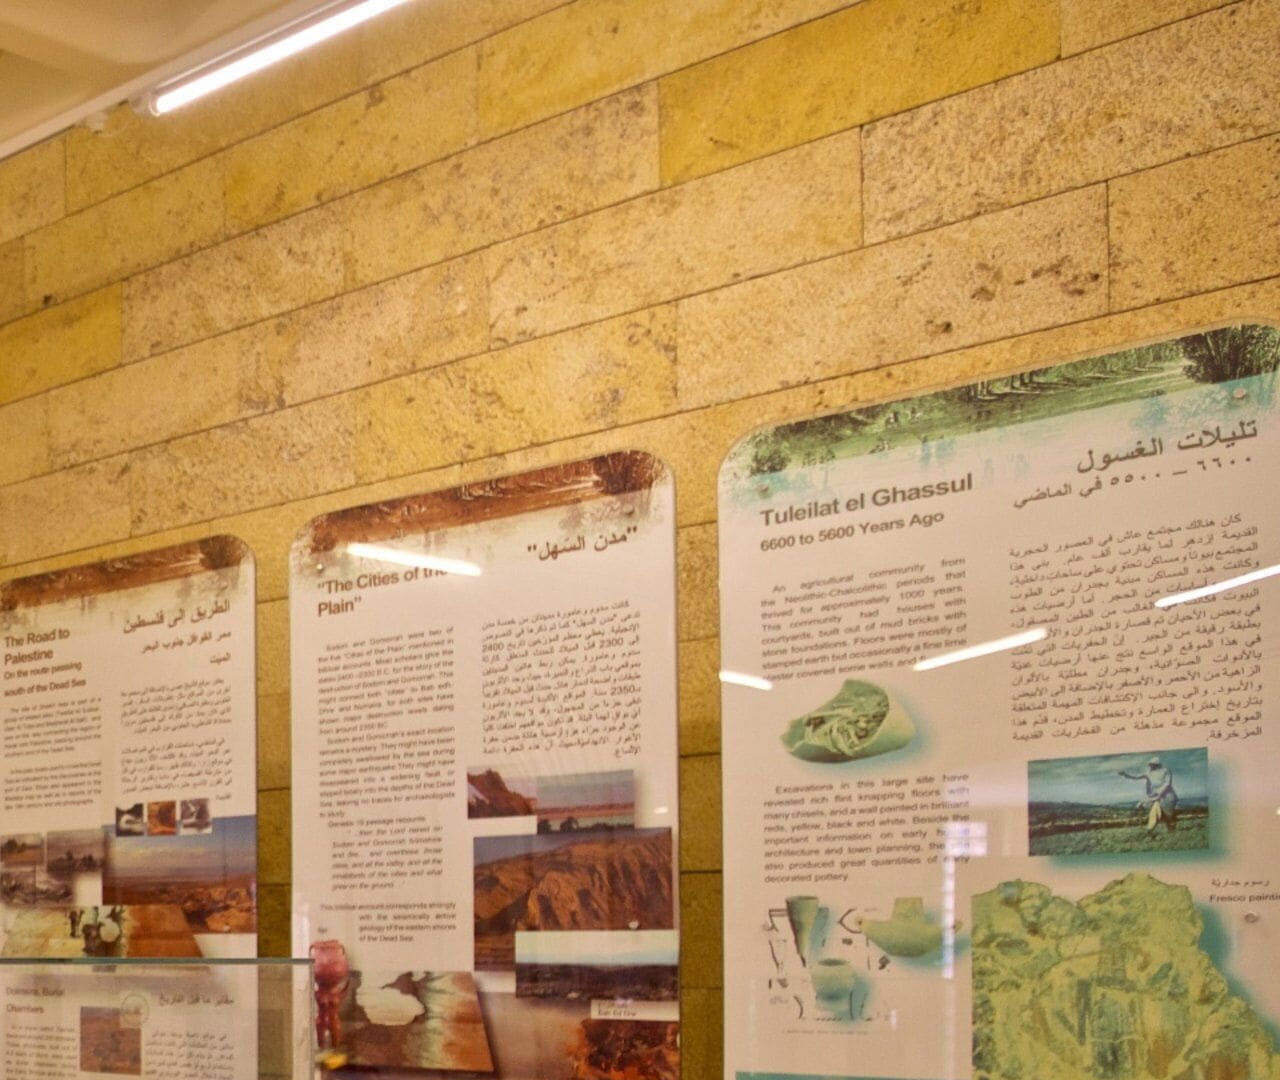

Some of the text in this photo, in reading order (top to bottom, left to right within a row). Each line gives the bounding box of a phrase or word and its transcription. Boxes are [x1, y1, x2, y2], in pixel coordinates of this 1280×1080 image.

[1077, 419, 1258, 473] تليلات الغسول
[760, 473, 972, 526] Tuleilat el Ghassul
[1014, 484, 1072, 508] الماضي
[1079, 477, 1102, 497] في
[760, 511, 944, 551] 6600 to 5600 Years Ago
[357, 572, 400, 589] Cities
[403, 566, 419, 581] of
[773, 557, 965, 593] An agricultural community from
[761, 599, 776, 608] the
[896, 575, 935, 589] periods
[945, 571, 966, 580] that
[761, 609, 793, 620] thrived
[800, 605, 813, 615] for
[821, 595, 890, 613] approximately
[900, 590, 925, 600] 1000
[761, 598, 966, 632] This community had houses with
[4, 628, 70, 647] The Road to
[819, 628, 840, 638] built
[844, 625, 861, 634] out
[865, 622, 876, 631] of
[880, 619, 903, 629] mud
[908, 614, 939, 625] bricks
[944, 611, 966, 620] with
[762, 647, 788, 657] stone
[853, 636, 885, 646] Floors
[889, 631, 915, 641] were
[918, 626, 952, 639] mostly
[957, 624, 967, 633] of
[4, 650, 54, 665] Palestine
[4, 671, 16, 680] On
[1210, 895, 1246, 903] Fresco
